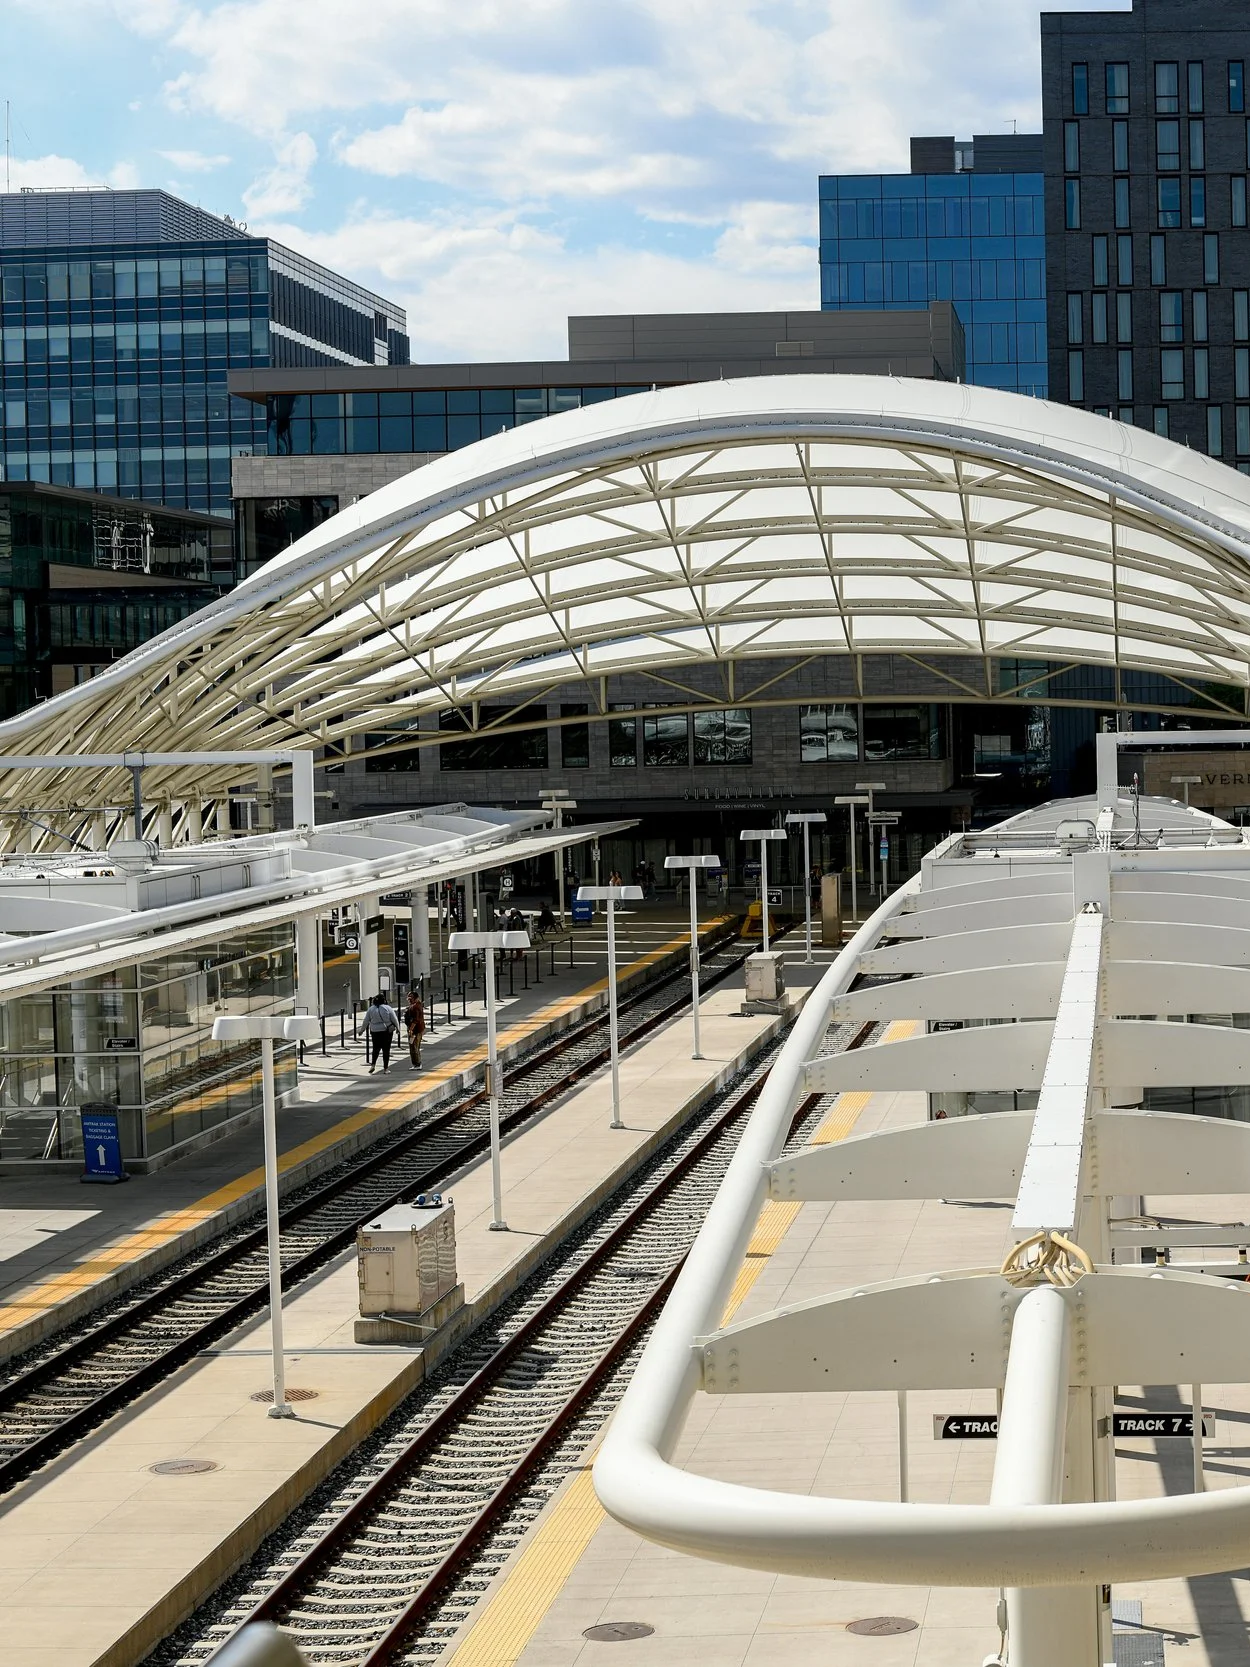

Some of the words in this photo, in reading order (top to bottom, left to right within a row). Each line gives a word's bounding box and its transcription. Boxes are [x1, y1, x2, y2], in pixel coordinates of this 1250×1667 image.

[684, 787, 739, 800] SUNDAY
[748, 786, 795, 798] VINYL
[963, 1422, 998, 1433] TRAC
[1119, 1420, 1165, 1431] TRACK
[1171, 1418, 1182, 1432] 7
